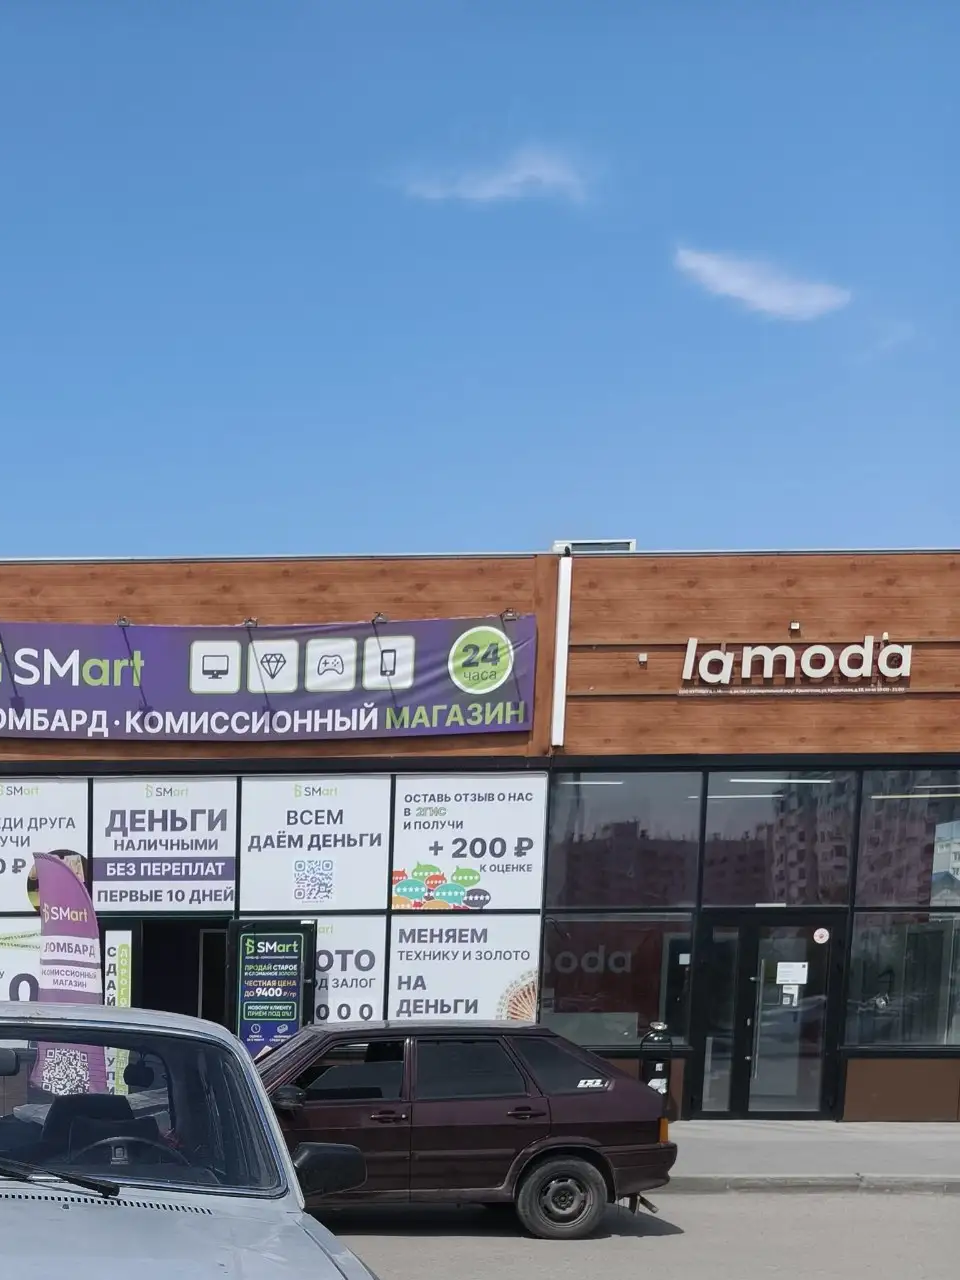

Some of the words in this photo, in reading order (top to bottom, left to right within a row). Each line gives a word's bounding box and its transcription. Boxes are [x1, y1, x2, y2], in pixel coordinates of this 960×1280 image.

[462, 642, 500, 668] 24
[681, 636, 913, 684] lamoda
[13, 647, 145, 688] SMart
[463, 669, 498, 683] часа
[125, 702, 378, 735] КОМИССИОННЫЙ
[385, 701, 526, 730] МАГАЗИН
[404, 793, 452, 803] ОСТАВЬ
[453, 793, 495, 802] ОТЗЫВ
[497, 792, 505, 802] О
[508, 792, 533, 802] НАС
[286, 809, 344, 825] ВСЕМ
[403, 808, 411, 817] В
[415, 807, 447, 817] 2ГИС
[27, 817, 76, 832] ДРУГА
[105, 808, 227, 837] ДЕНЬГИ
[403, 821, 411, 830] И
[414, 820, 464, 830] ПОЛУЧИ
[114, 839, 218, 851] НАЛИЧНЫМИ
[248, 830, 303, 852] ДАЁМ
[307, 833, 382, 851] ДЕНЬГИ
[451, 837, 506, 859] 200
[106, 862, 135, 876] БЕЗ
[140, 862, 226, 876] ПЕРЕПЛАТ
[479, 864, 486, 872] К
[489, 863, 533, 873] ОЦЕНКЕ
[97, 890, 162, 903] ПЕРВЫЕ
[166, 889, 185, 902] 10
[189, 887, 234, 904] ДНЕЙ
[50, 906, 88, 922] SMart
[398, 928, 488, 943] МЕНЯЕМ
[43, 941, 96, 958] ЛОМБАРД
[256, 941, 298, 953] SMart
[398, 950, 459, 961] ТЕХНИКУ
[463, 950, 471, 961] И
[475, 950, 531, 961] ЗОЛОТО
[244, 963, 272, 971] ПРОДАЙ
[52, 979, 87, 988] МАГАЗИН
[106, 946, 117, 1006] СДАЙ
[397, 975, 427, 991] НА
[314, 978, 328, 991] Д
[332, 977, 376, 989] ЗАЛОГ
[255, 987, 282, 997] 9400
[396, 999, 478, 1017] ДЕНЬГИ
